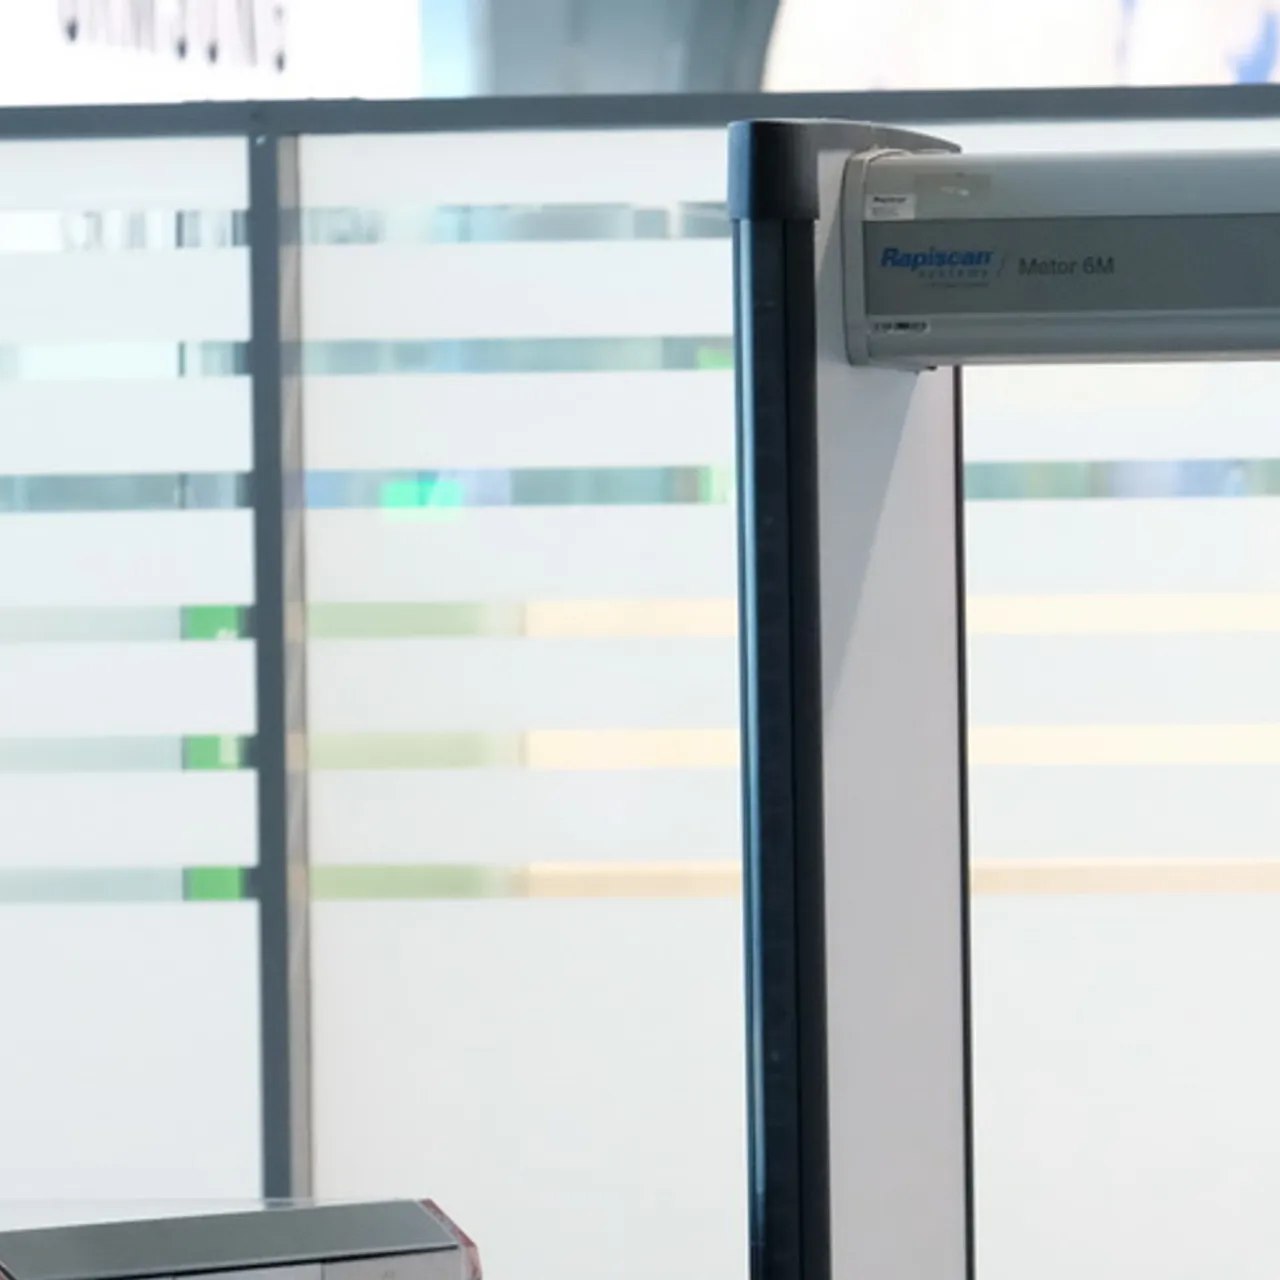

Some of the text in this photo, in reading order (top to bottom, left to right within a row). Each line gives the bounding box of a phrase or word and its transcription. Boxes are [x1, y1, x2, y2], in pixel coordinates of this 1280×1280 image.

[881, 247, 993, 271] Rapiscan
[1019, 256, 1115, 275] Metor 6M
